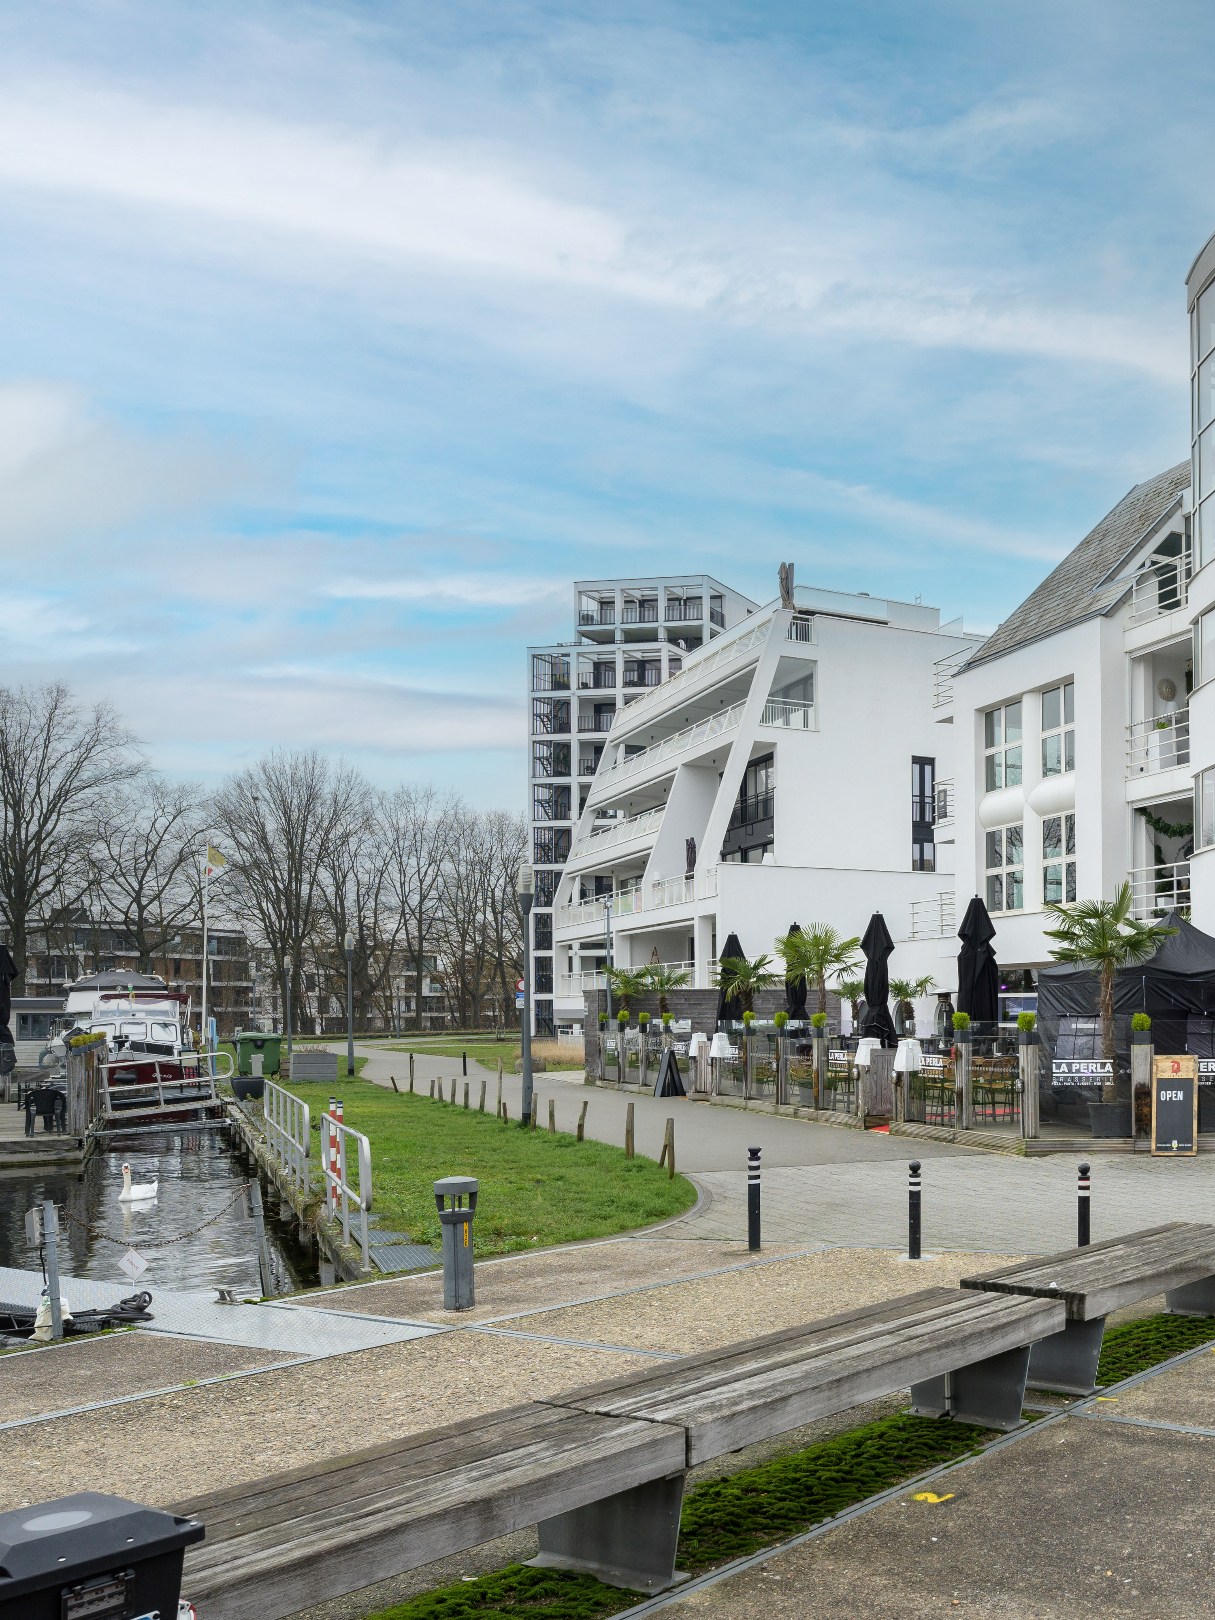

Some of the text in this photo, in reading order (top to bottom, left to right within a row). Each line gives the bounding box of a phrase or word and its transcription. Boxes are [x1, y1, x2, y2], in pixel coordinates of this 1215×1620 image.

[926, 1057, 943, 1067] PERLA
[1052, 1062, 1114, 1073] LA PERLA
[1160, 1090, 1184, 1101] OPEN
